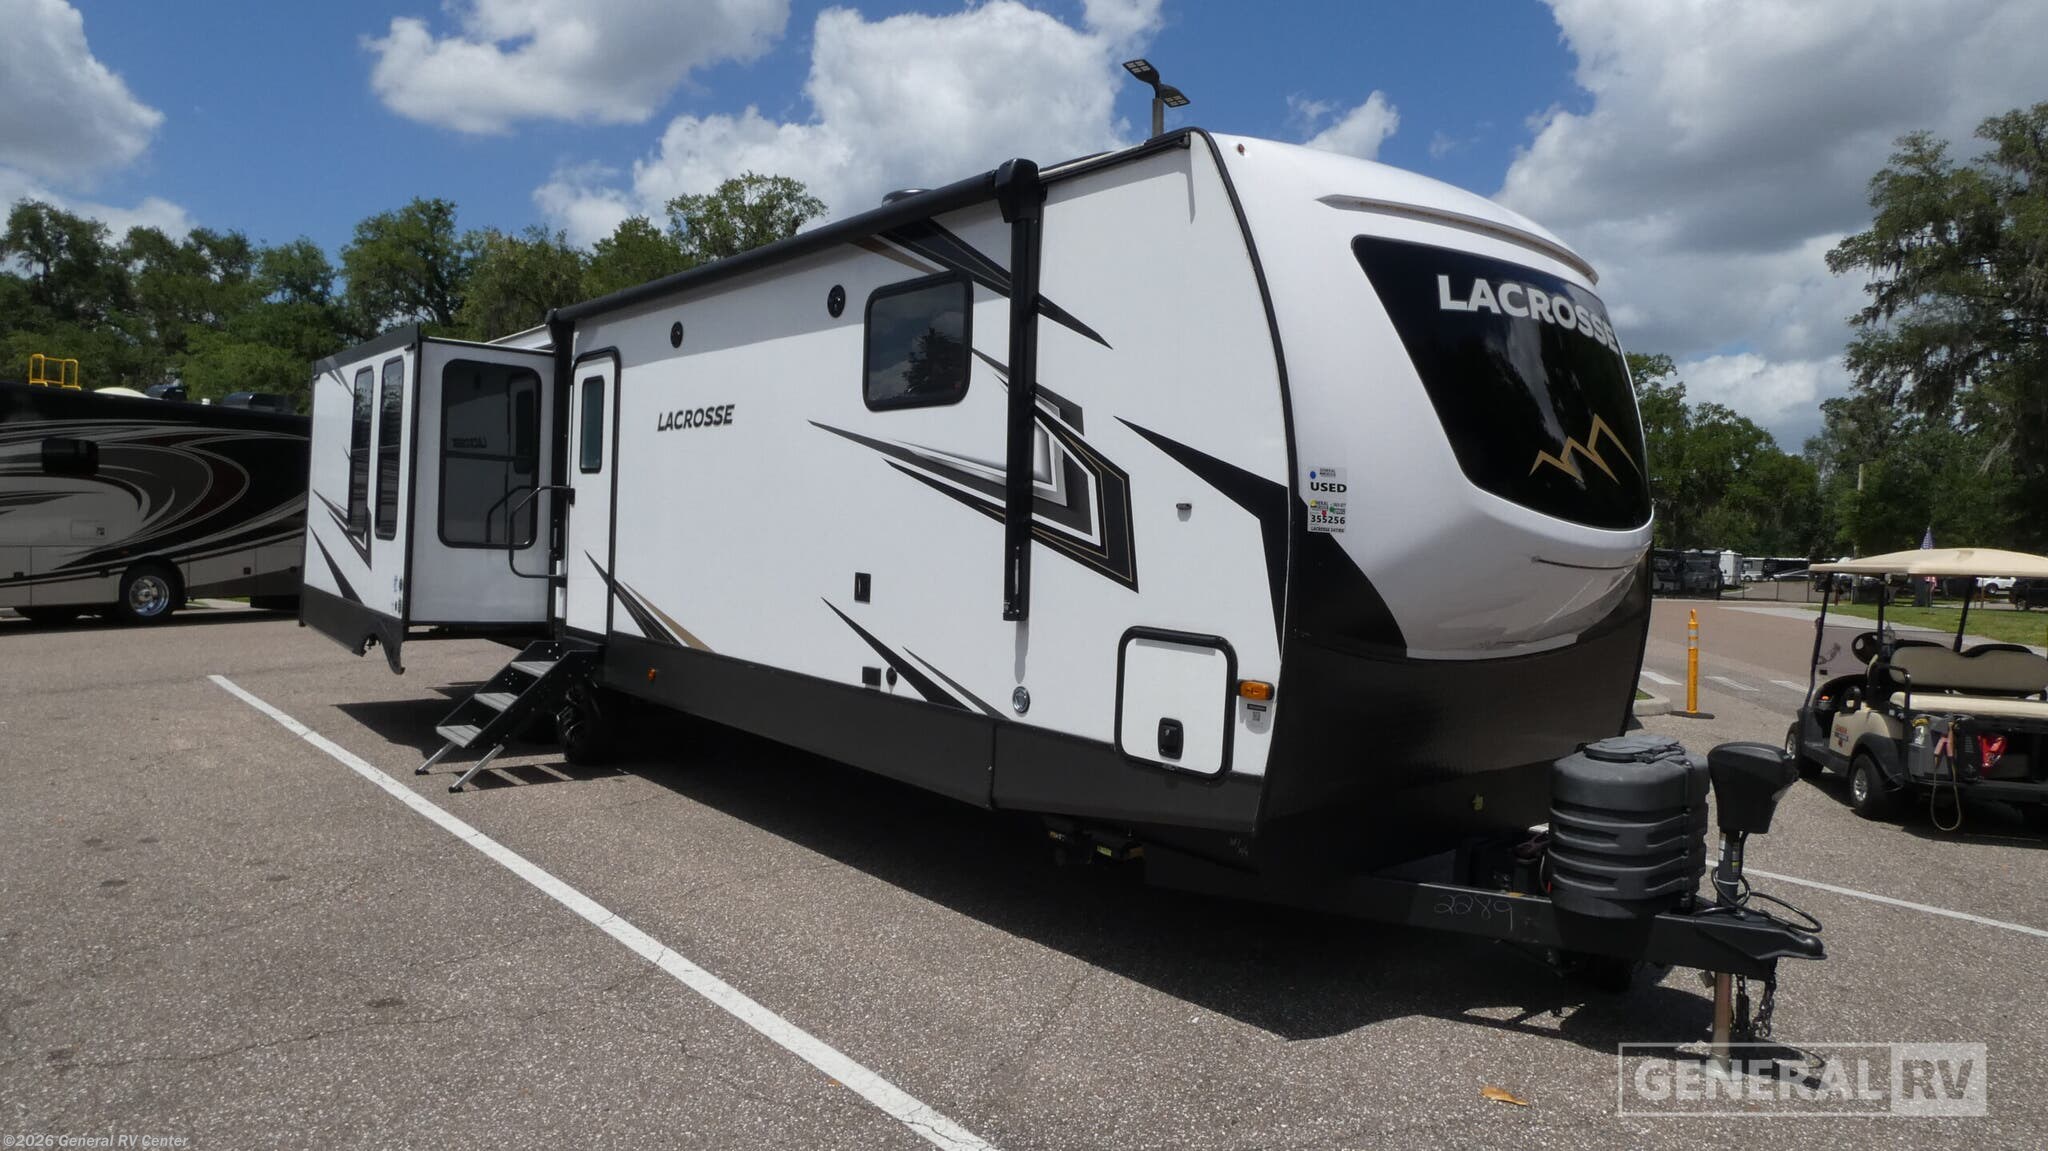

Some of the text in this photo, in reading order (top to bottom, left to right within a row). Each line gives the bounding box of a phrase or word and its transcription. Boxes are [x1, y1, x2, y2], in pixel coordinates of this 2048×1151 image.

[1437, 274, 1619, 354] LACROSSE
[657, 403, 735, 432] LACROSSE
[1310, 482, 1347, 493] USED
[1311, 514, 1346, 525] 355256
[1434, 894, 1513, 931] 2289
